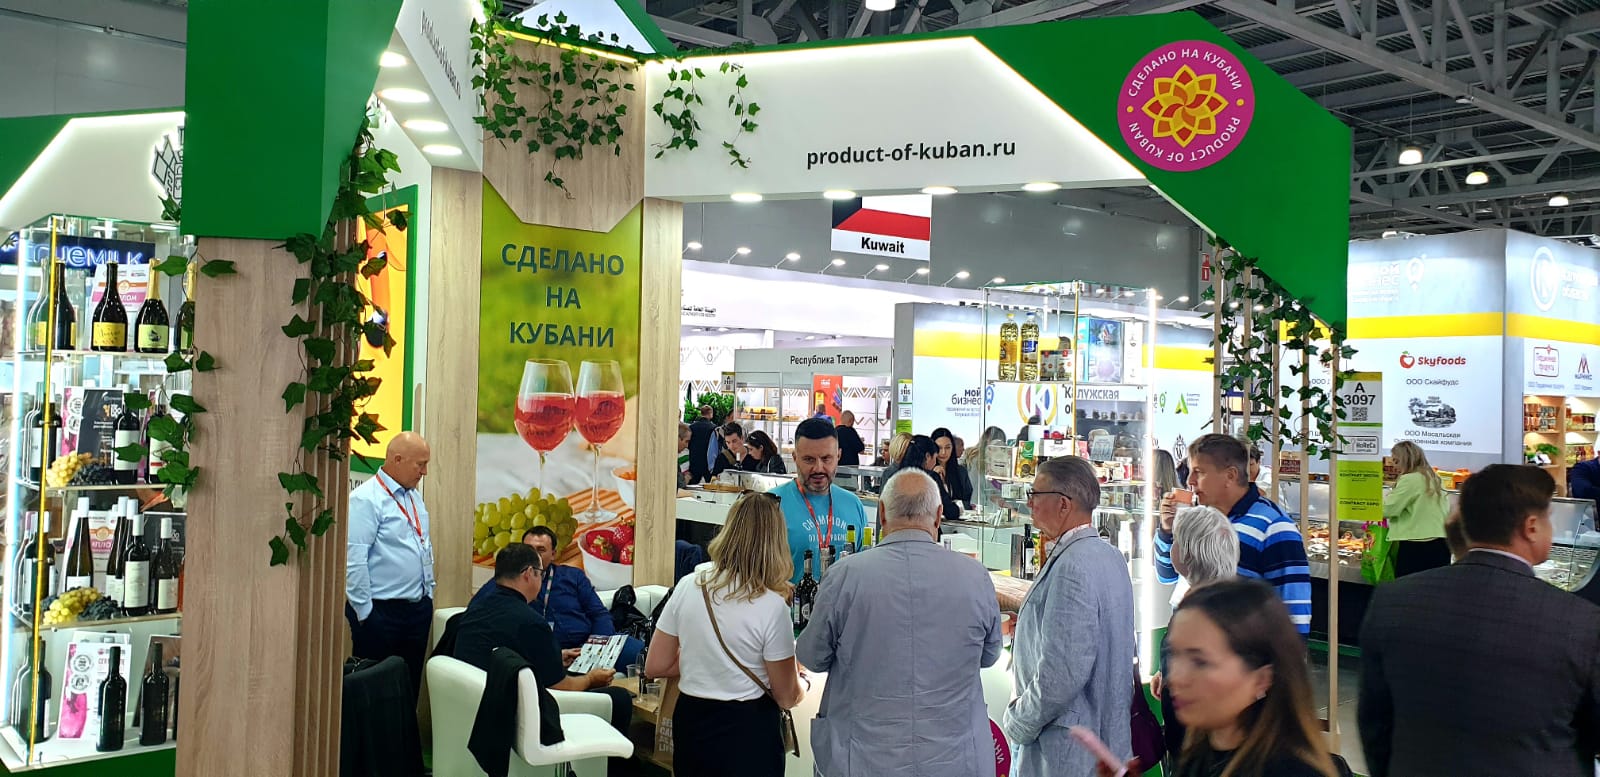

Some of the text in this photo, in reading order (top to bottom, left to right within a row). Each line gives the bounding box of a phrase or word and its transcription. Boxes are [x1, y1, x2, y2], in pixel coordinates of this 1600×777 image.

[1128, 48, 1243, 97] СДЕЛАНО НА КУБАНИ
[1128, 117, 1241, 162] PRODUCT OF KUBAN
[807, 140, 1016, 170] product-of-kuban.ru
[861, 236, 905, 254] Kuwait
[501, 243, 625, 276] СДЕЛАНО
[546, 286, 582, 310] НА
[510, 321, 614, 349] КУБАНИ
[790, 354, 878, 367] Республика Татарстан
[1417, 356, 1467, 367] Skyfoods
[1354, 382, 1365, 393] A
[1424, 378, 1460, 386] Скайфудс
[951, 394, 982, 405] бизнес
[964, 387, 982, 397] мой
[1344, 394, 1376, 405] 3097
